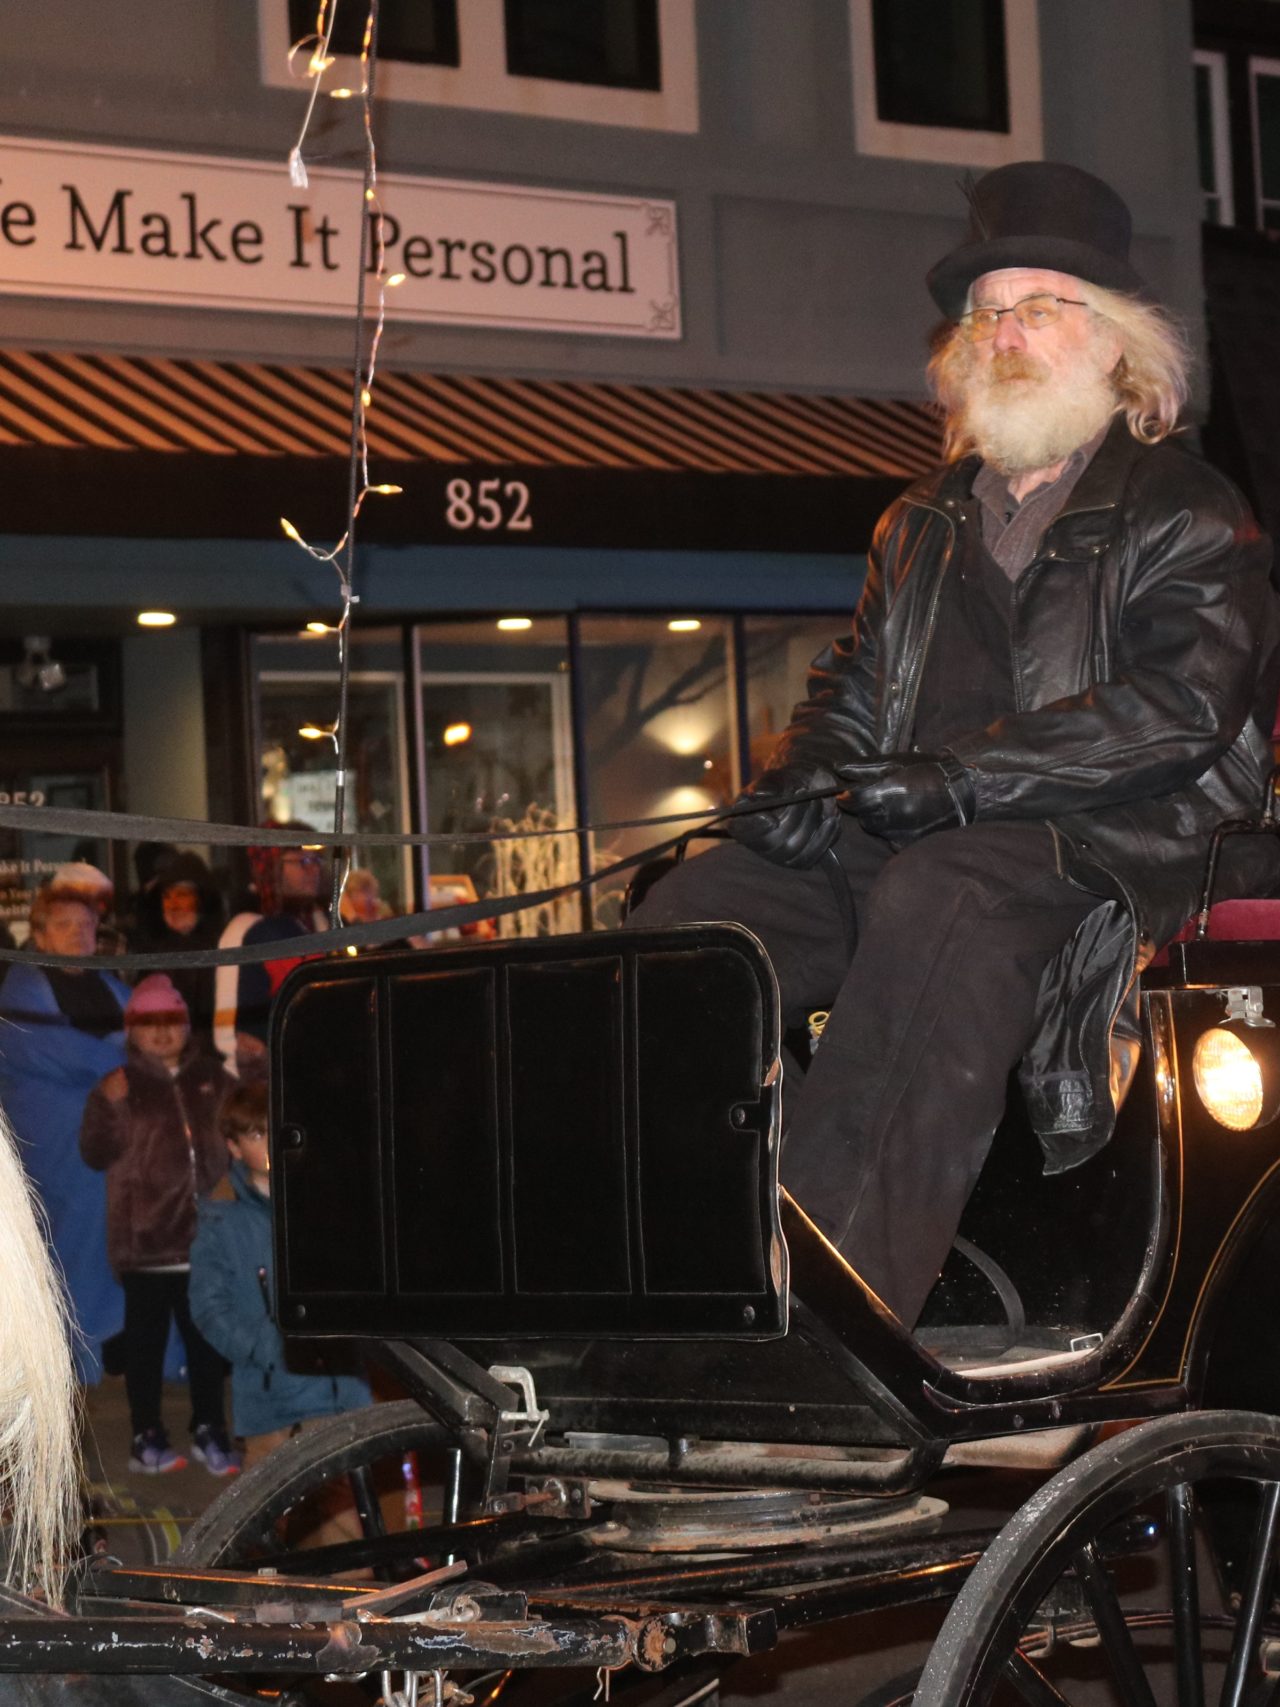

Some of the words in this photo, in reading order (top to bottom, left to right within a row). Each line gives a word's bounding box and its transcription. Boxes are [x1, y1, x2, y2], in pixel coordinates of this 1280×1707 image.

[0, 179, 37, 247] e
[61, 184, 264, 264] Make
[287, 205, 340, 270] It
[366, 210, 637, 294] Personal
[445, 477, 533, 531] 852
